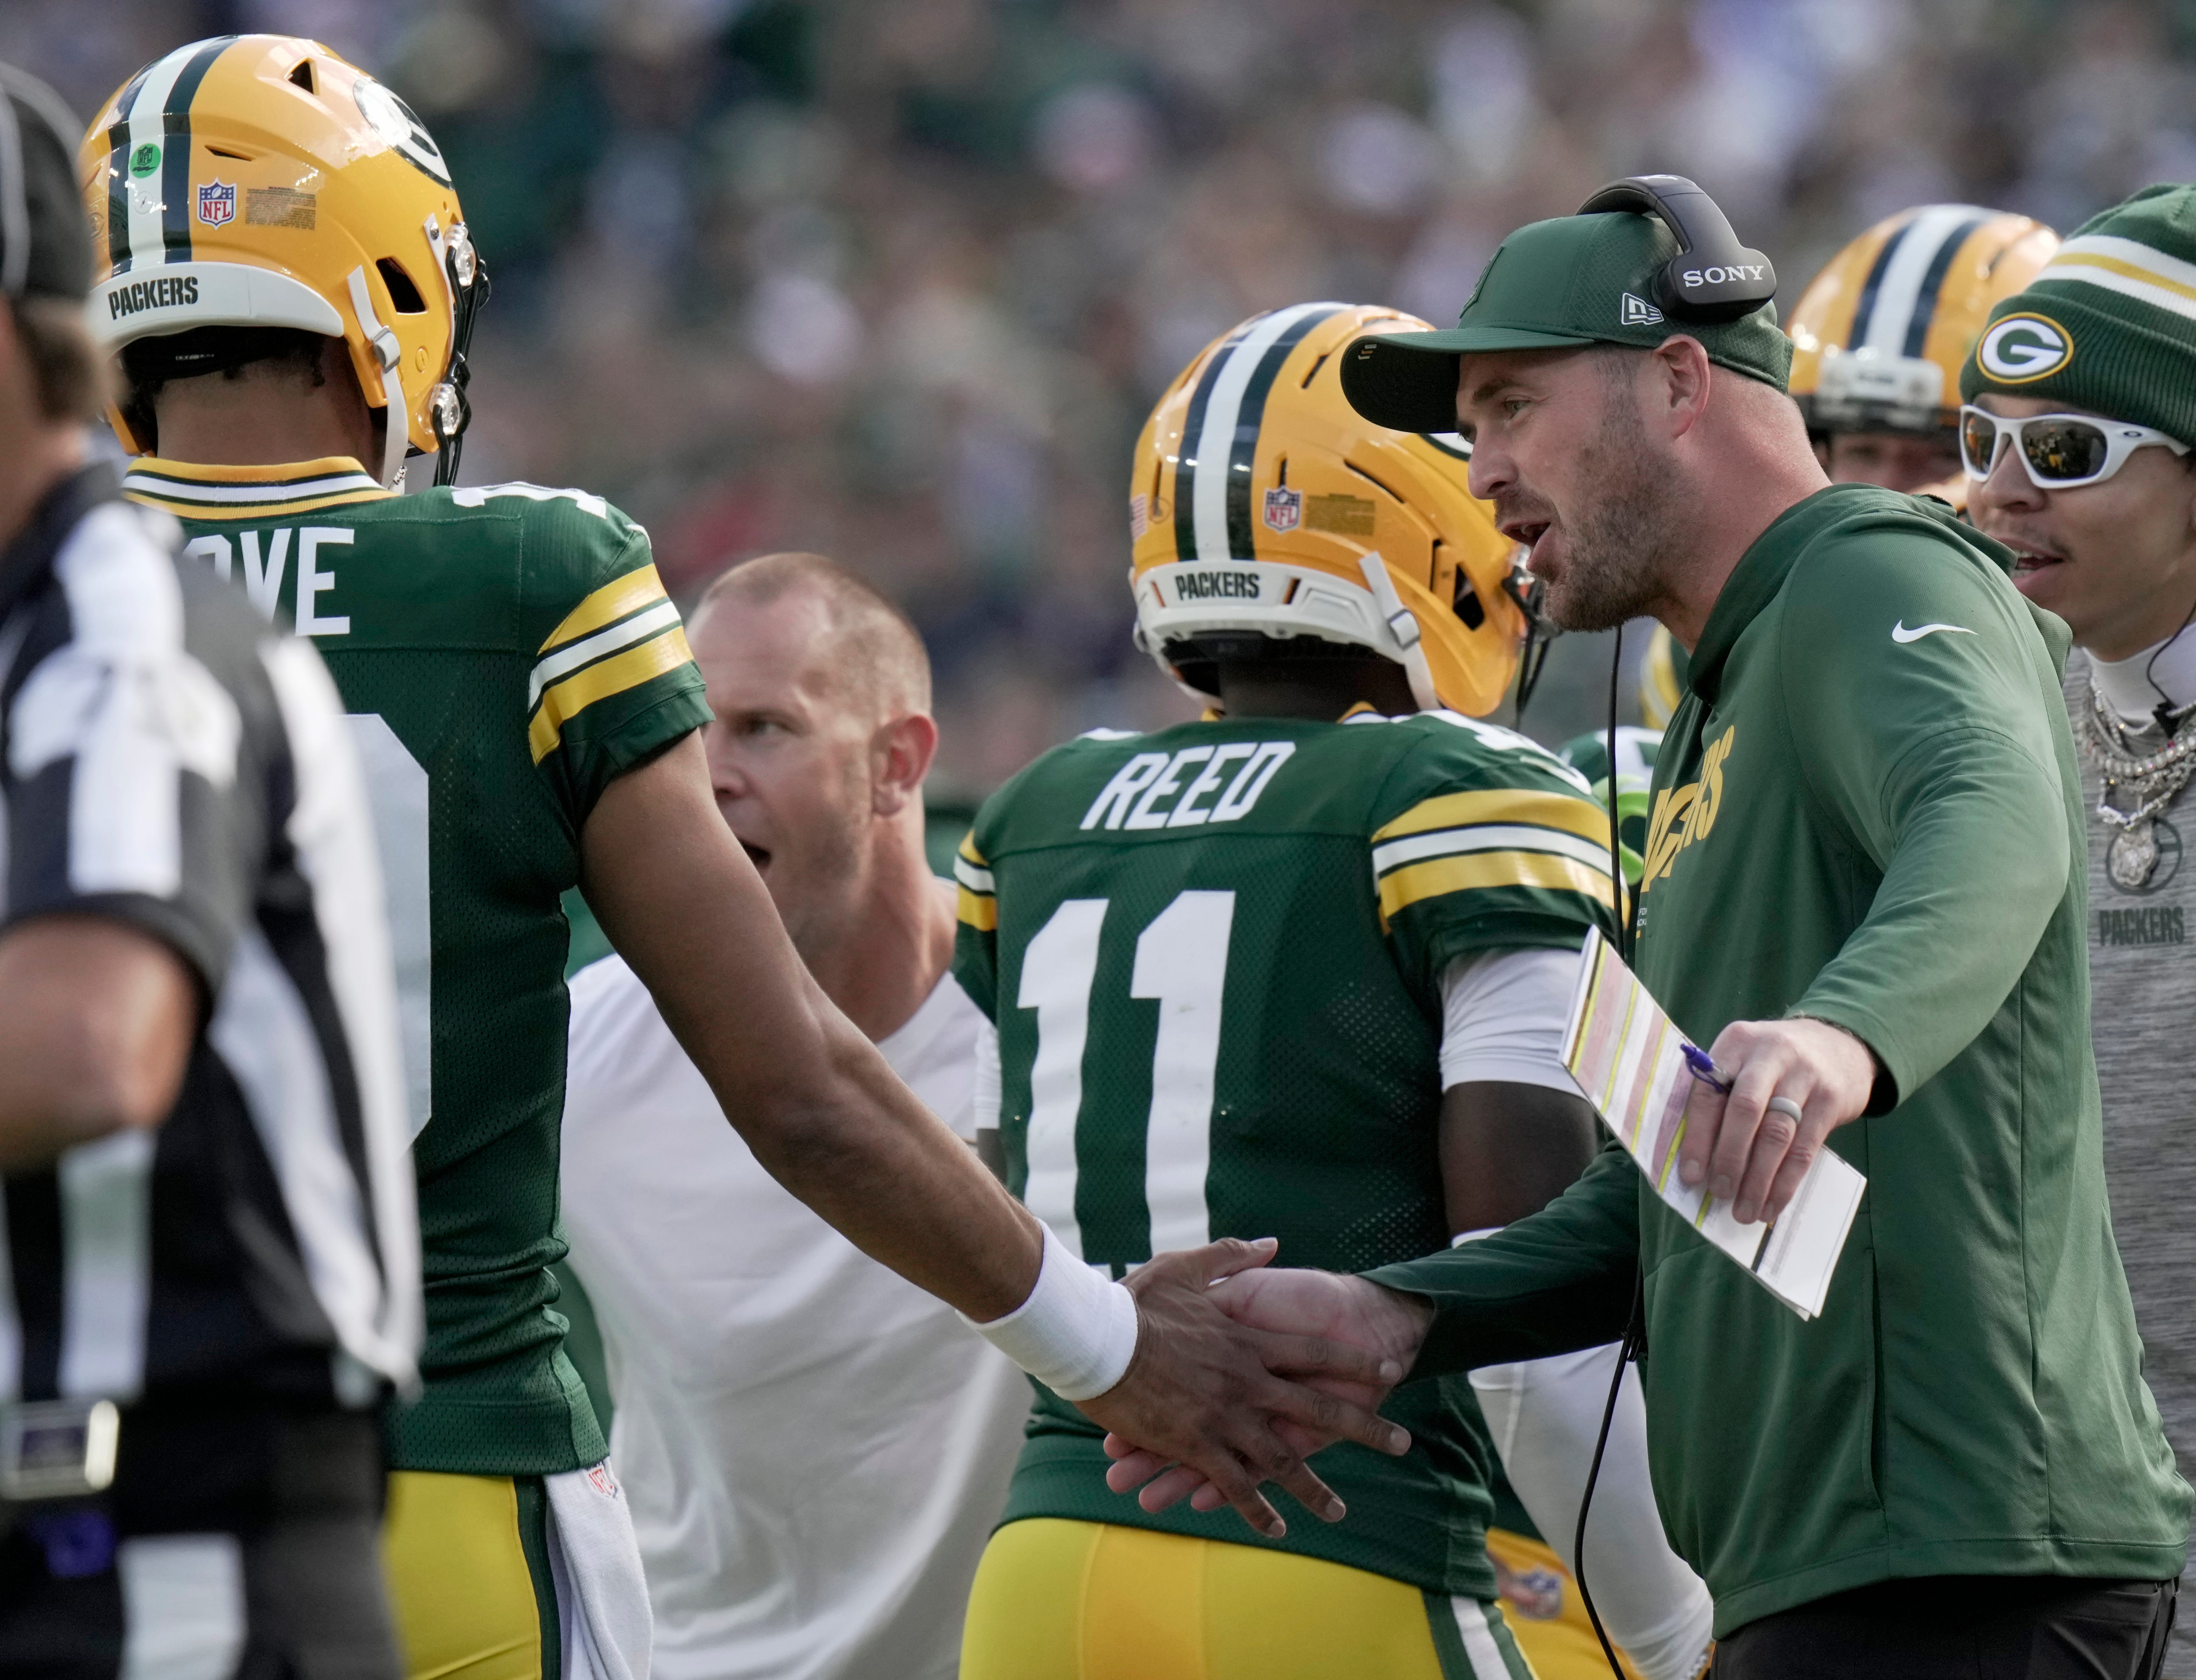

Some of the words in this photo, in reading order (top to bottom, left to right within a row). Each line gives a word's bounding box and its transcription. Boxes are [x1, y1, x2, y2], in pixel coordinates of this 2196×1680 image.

[203, 201, 230, 220] NFL
[1683, 265, 1764, 288] SONY
[108, 276, 198, 320] PACKERS
[1269, 506, 1296, 526] NFL
[1175, 571, 1260, 601] PACKERS
[1080, 741, 1296, 830] REED
[2099, 906, 2184, 946] PACKERS
[1017, 890, 1235, 1280] 11
